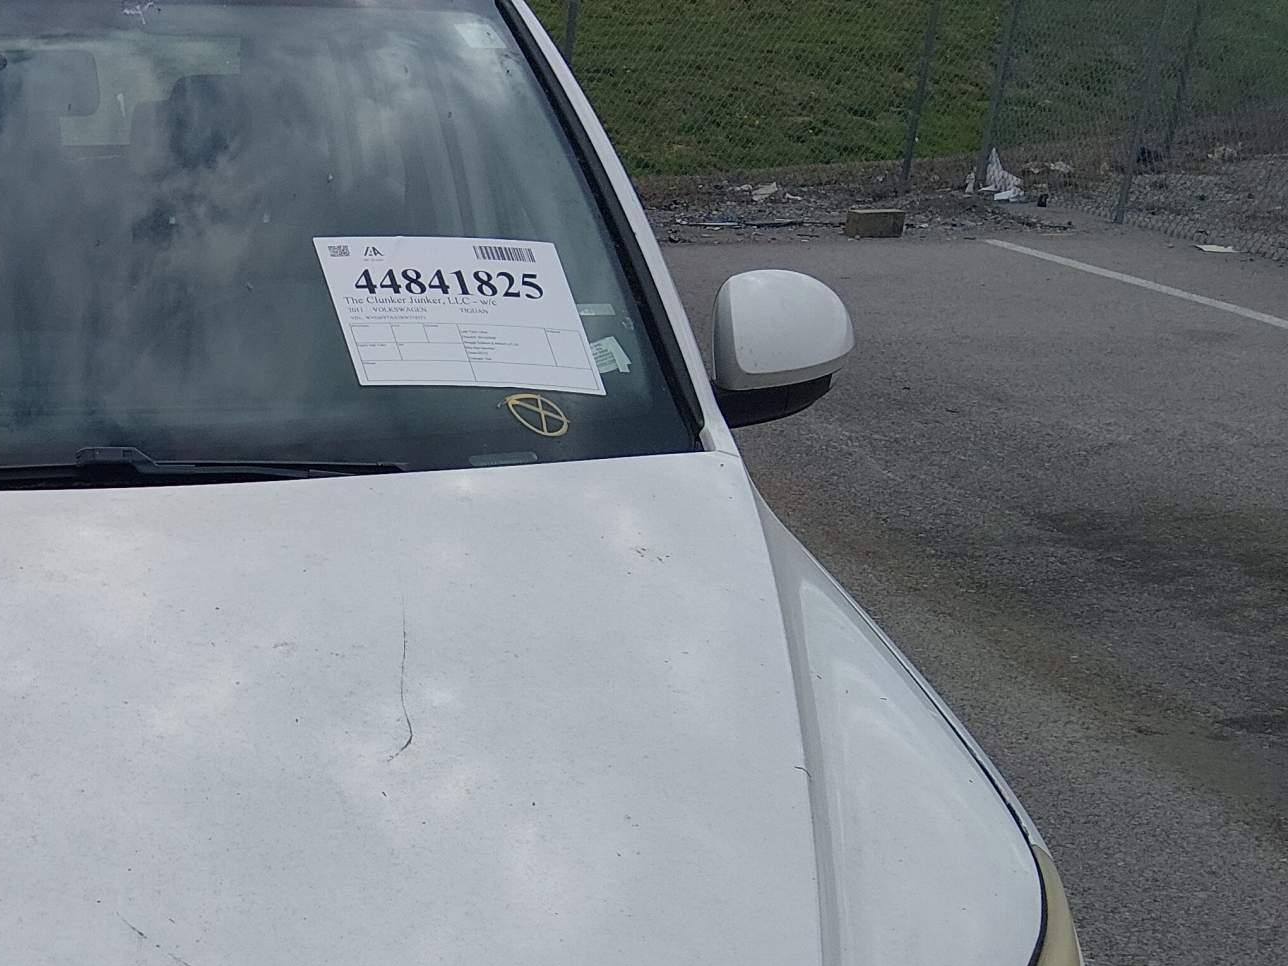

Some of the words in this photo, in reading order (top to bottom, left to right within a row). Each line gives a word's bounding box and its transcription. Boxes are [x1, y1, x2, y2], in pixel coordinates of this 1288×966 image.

[354, 268, 544, 300] 44841825
[344, 296, 364, 305] The
[366, 296, 407, 305] Clunker
[448, 297, 470, 306] LLC
[371, 306, 428, 314] VOLKSWAGEN
